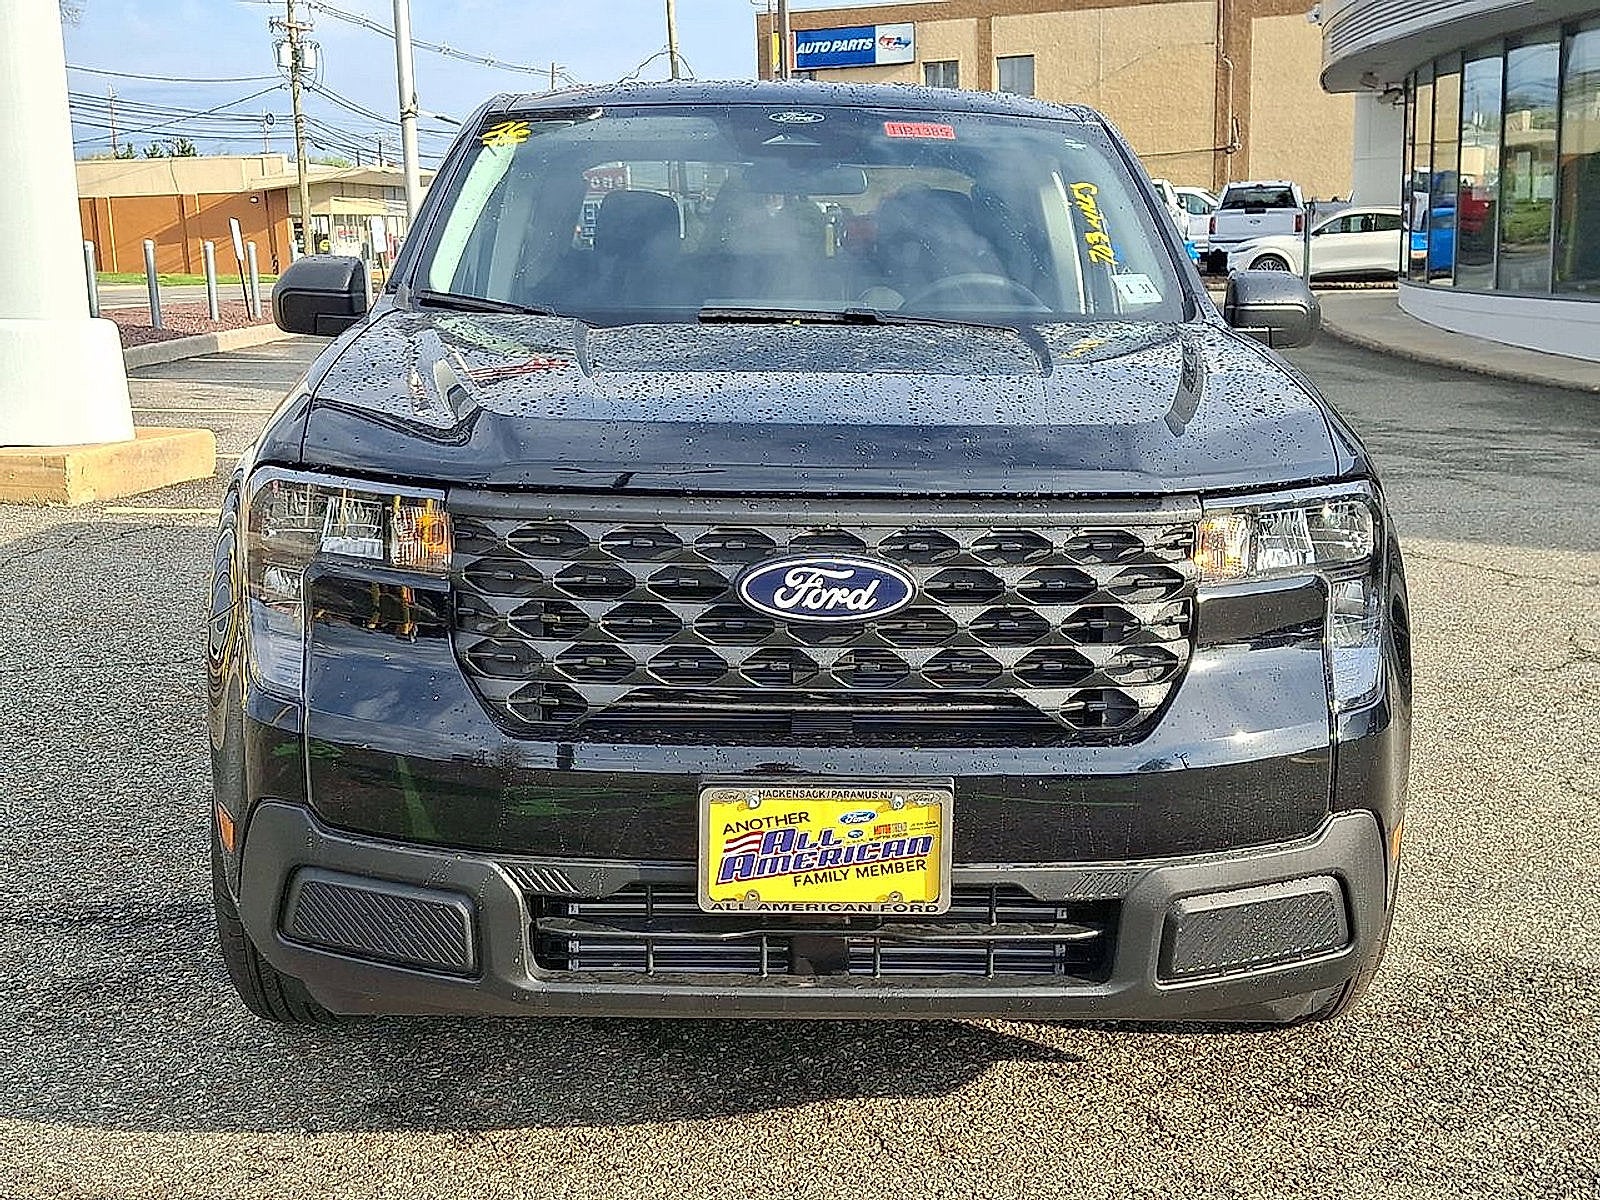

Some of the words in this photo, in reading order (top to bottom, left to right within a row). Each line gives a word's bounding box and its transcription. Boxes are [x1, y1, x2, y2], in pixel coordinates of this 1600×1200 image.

[796, 41, 832, 54] AUTO
[831, 38, 874, 52] PARTS
[773, 566, 882, 610] Ford
[758, 789, 879, 799] HACKENSACK/PARAMUS
[880, 790, 894, 799] NJ
[722, 811, 811, 835] ANOTHER
[793, 868, 850, 887] FAMILY
[856, 858, 927, 879] MEMBER
[710, 902, 748, 912] ALL
[757, 902, 872, 913] AMERICAN
[880, 902, 939, 913] FORD
